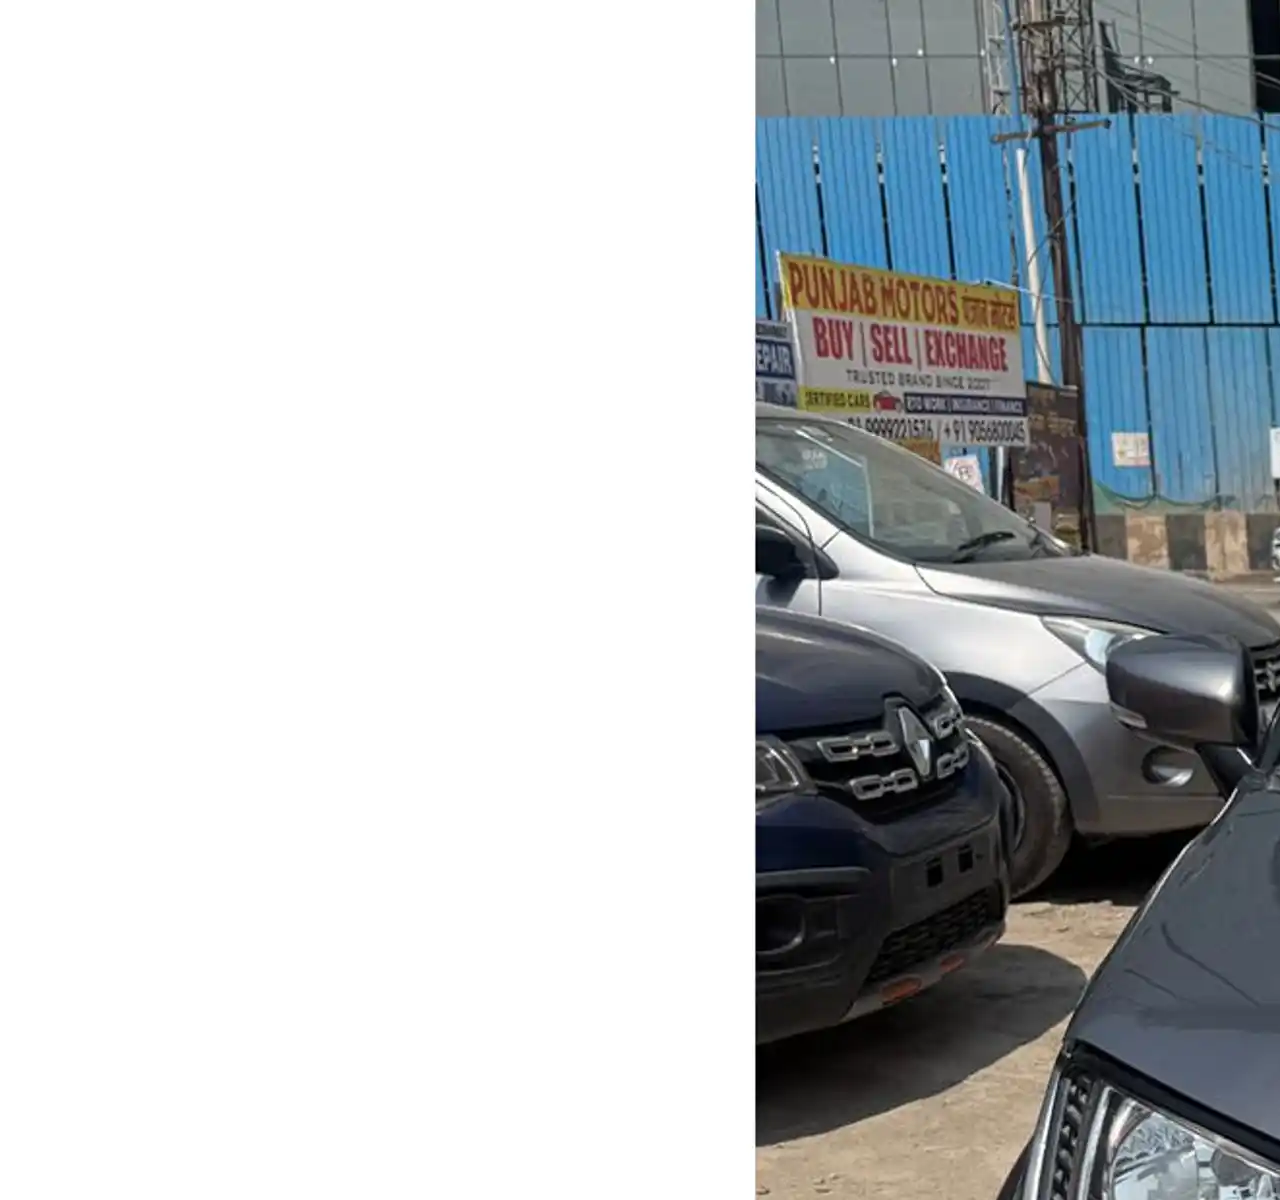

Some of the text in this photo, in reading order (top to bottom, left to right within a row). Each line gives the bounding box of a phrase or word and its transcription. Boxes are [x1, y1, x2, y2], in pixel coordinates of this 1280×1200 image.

[788, 261, 959, 327] PUNJAB MOTORS
[812, 316, 1009, 372] BUY SELL EXCHANGE
[846, 369, 895, 386] TRUSTED
[898, 372, 933, 388] BRAND
[936, 374, 965, 390] SINCE
[848, 392, 870, 409] CARS
